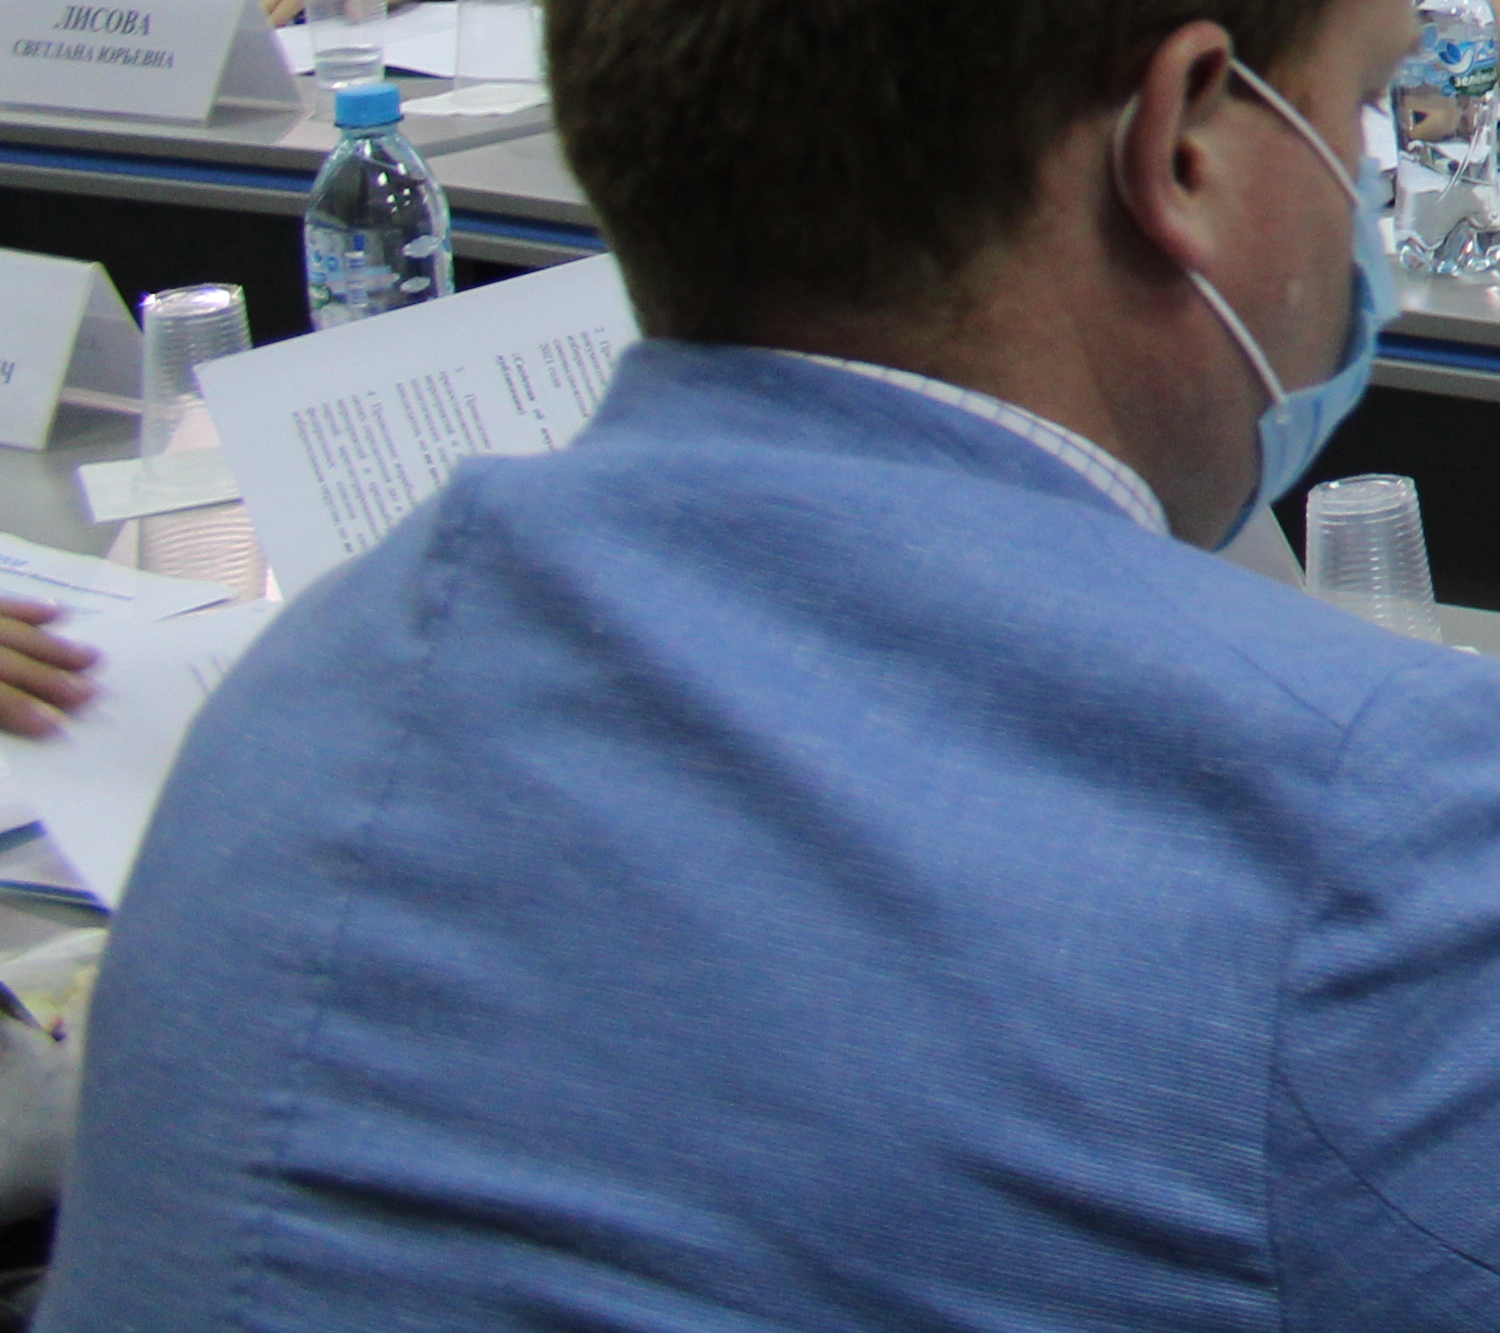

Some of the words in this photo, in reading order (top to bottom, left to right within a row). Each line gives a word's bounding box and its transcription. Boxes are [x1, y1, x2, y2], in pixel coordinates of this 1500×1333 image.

[53, 4, 153, 36] ЛИСОВА
[12, 38, 94, 63] СВЕТЛАНА
[96, 44, 174, 69] ЮРЬЕВНА
